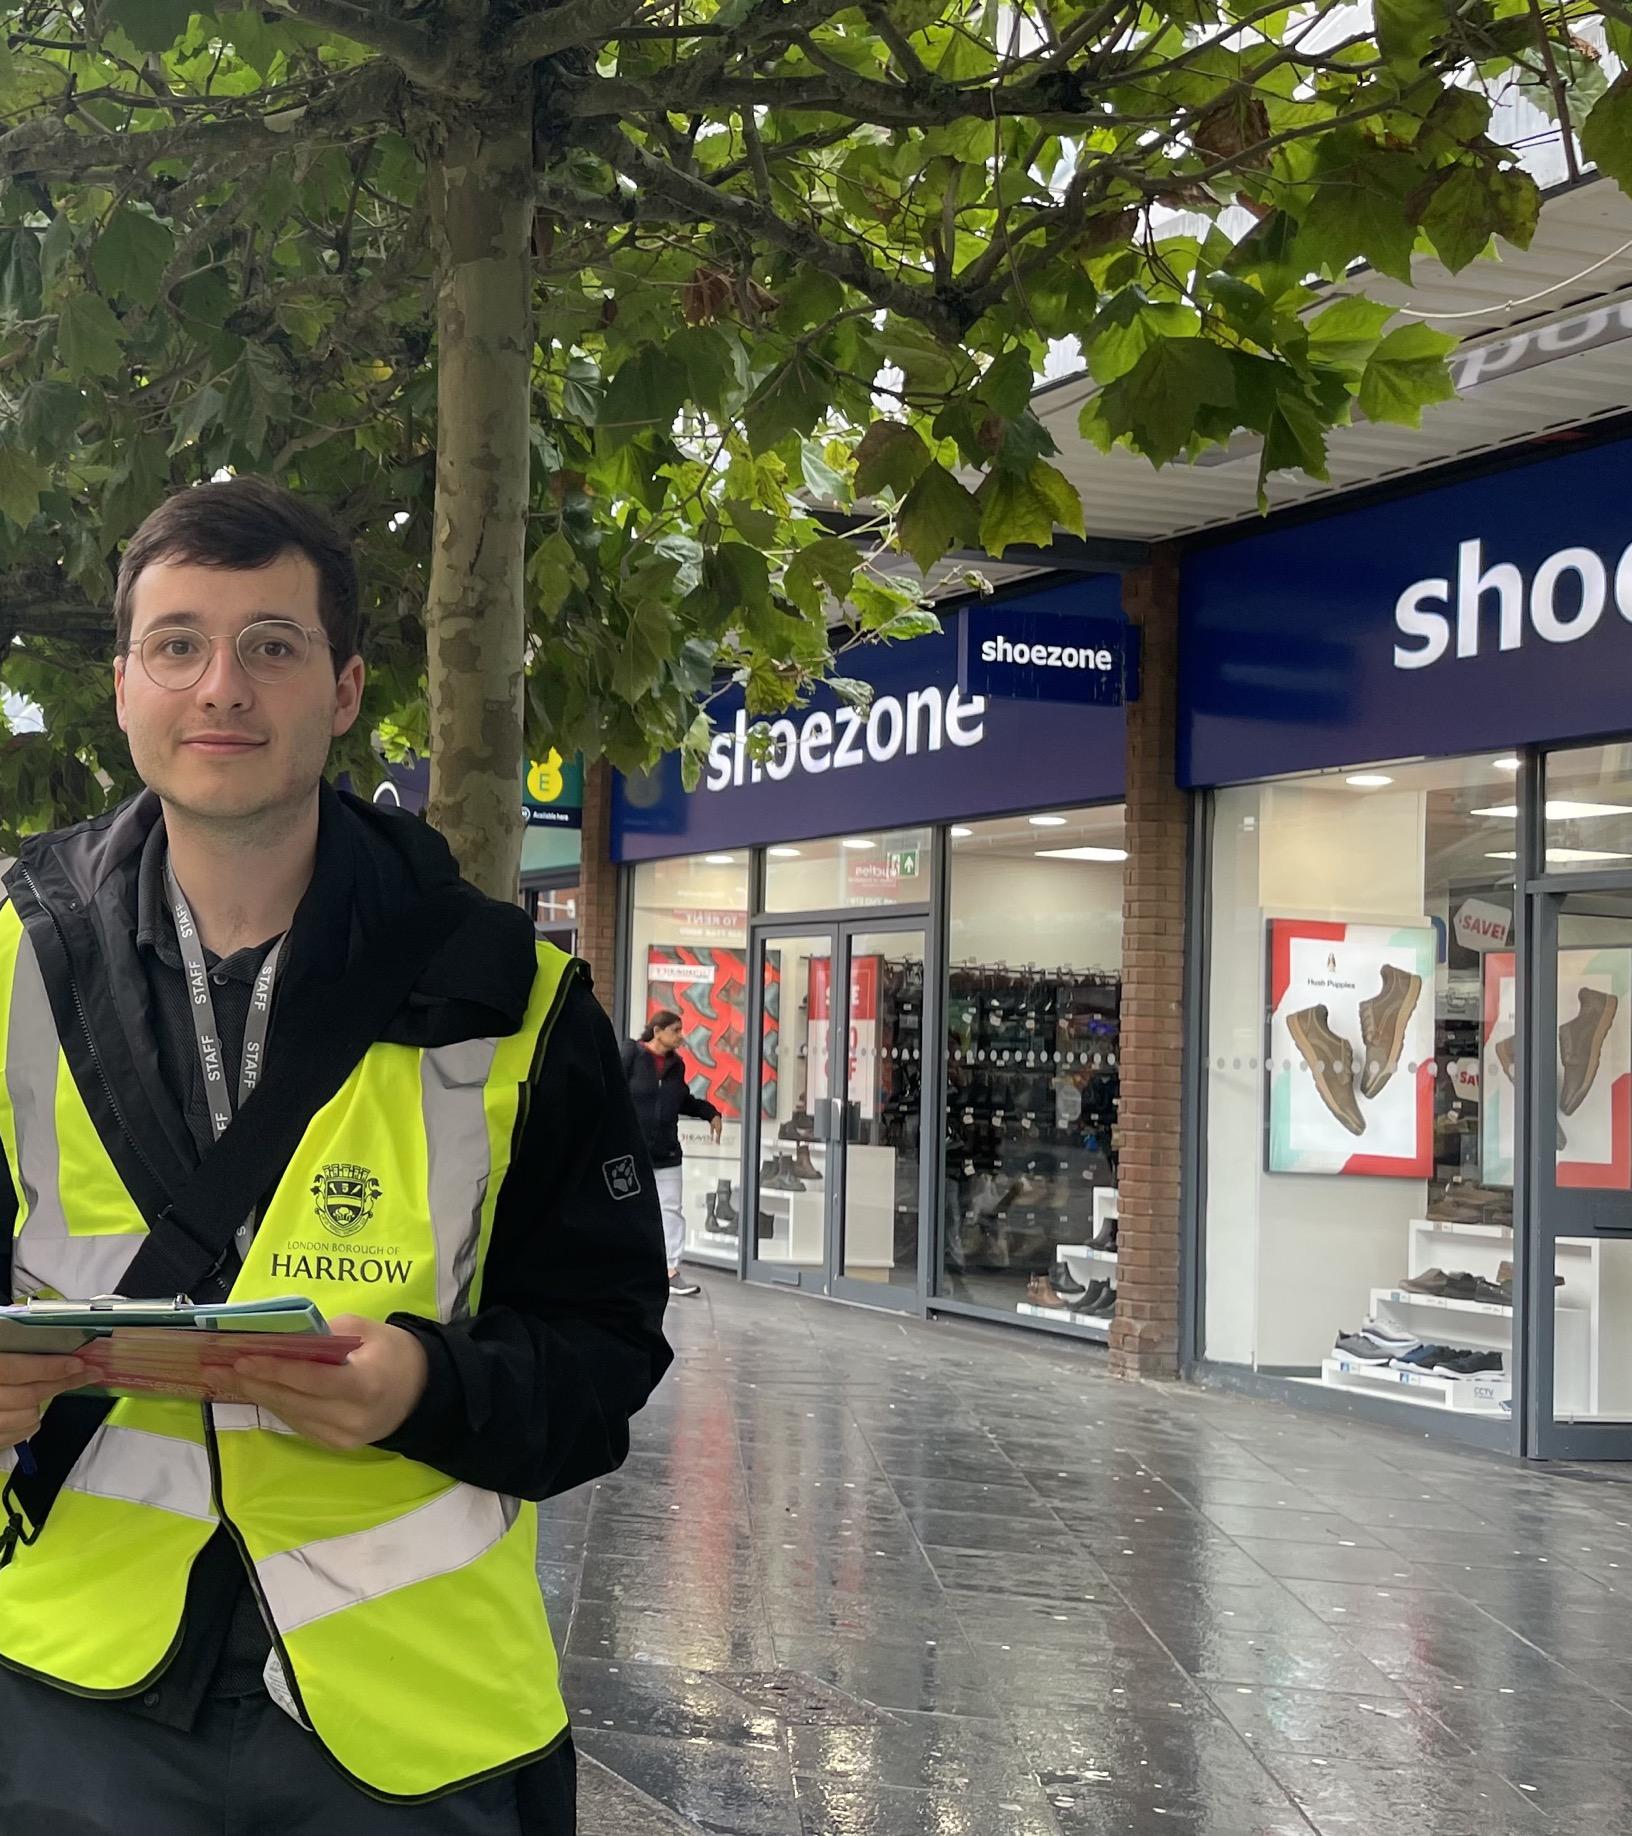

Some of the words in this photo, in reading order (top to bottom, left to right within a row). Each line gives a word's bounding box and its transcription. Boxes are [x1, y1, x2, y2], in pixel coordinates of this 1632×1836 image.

[981, 635, 1112, 671] shoezone
[706, 684, 985, 792] shoezone
[174, 904, 194, 938] STAFF
[1462, 913, 1506, 941] SAVE!
[187, 960, 207, 1005] STAFF
[253, 965, 273, 1011] STAFF
[201, 1034, 222, 1082] STAFF
[243, 1041, 260, 1090] STAFF
[271, 1253, 414, 1284] HARROW
[287, 1241, 331, 1252] LONDON
[331, 1243, 384, 1255] BOROUGH
[386, 1246, 400, 1256] OF
